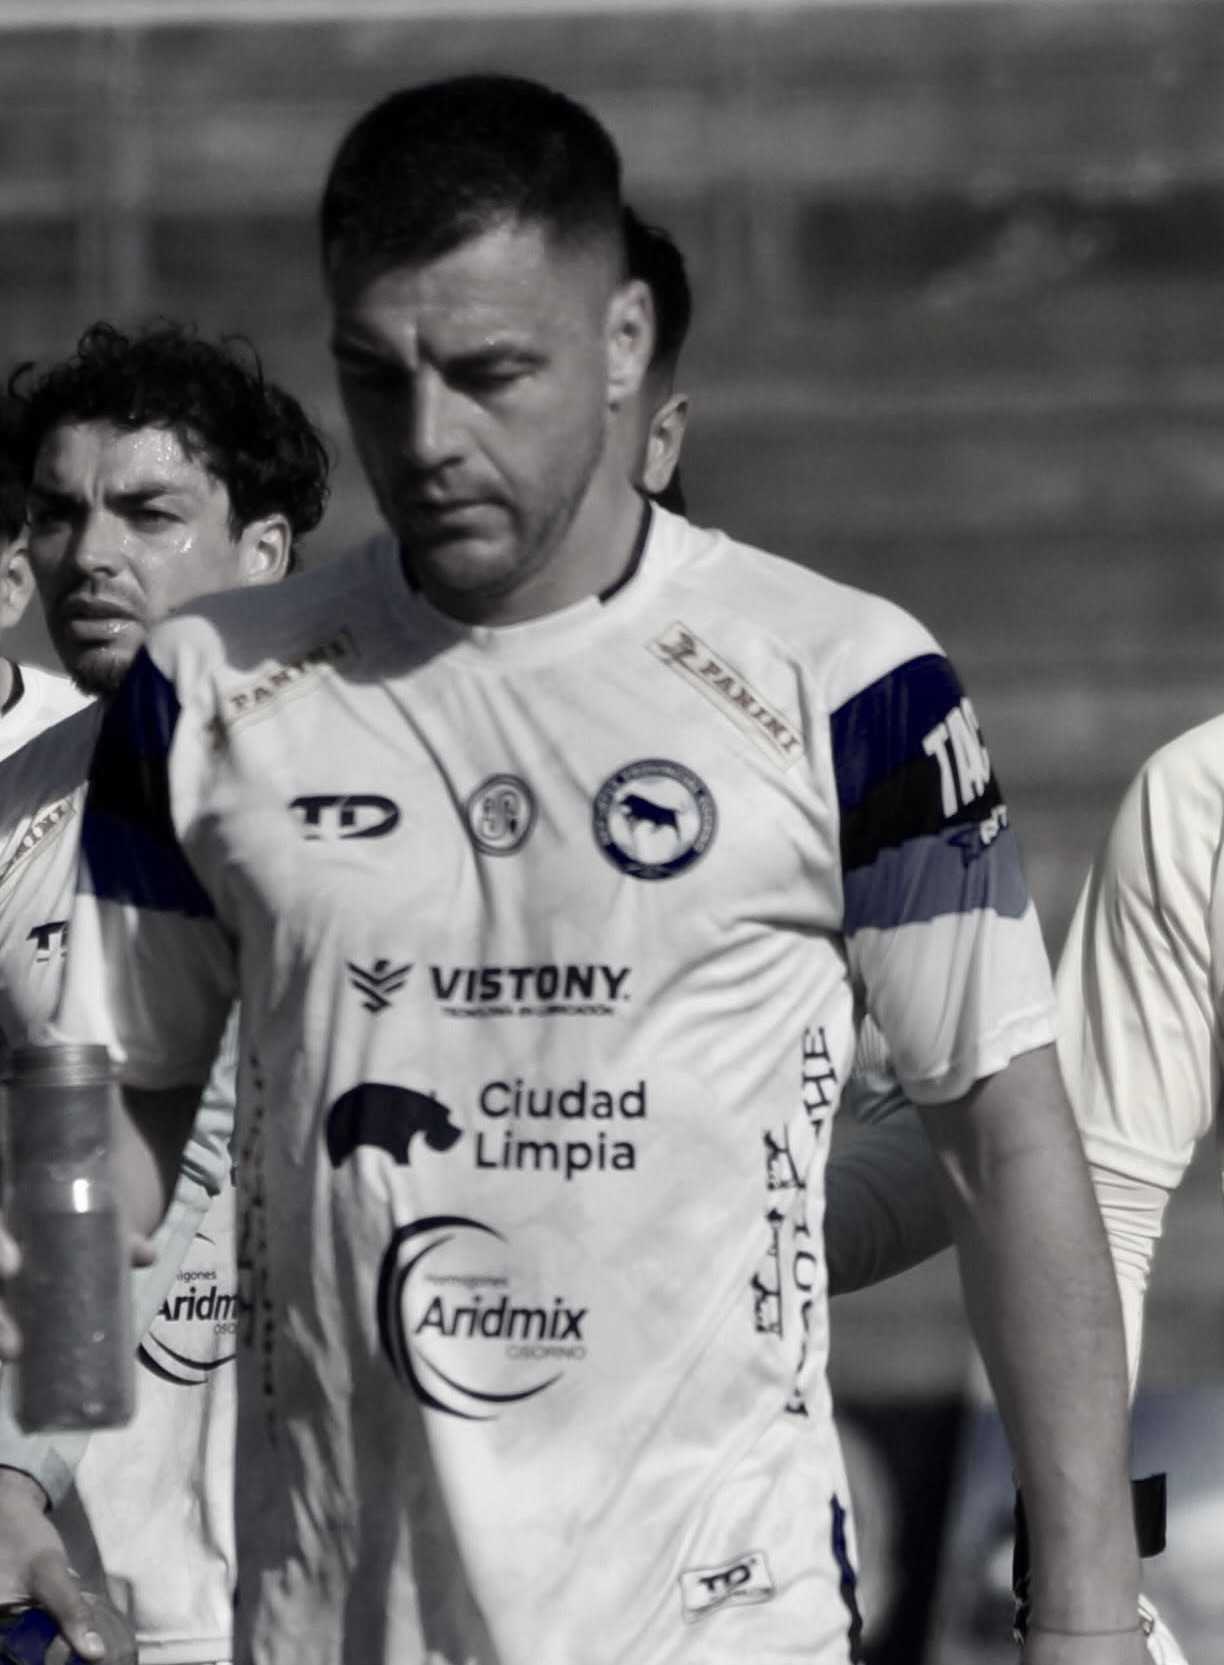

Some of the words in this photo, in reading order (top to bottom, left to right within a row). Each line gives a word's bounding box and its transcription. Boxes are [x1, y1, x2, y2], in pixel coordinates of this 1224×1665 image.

[700, 658, 800, 752] PANINI
[287, 795, 399, 839] TD
[430, 965, 630, 1001] VISTONY
[480, 1080, 646, 1120] Ciudad
[477, 1132, 635, 1180] Limpia
[415, 1296, 588, 1340] Aridmix
